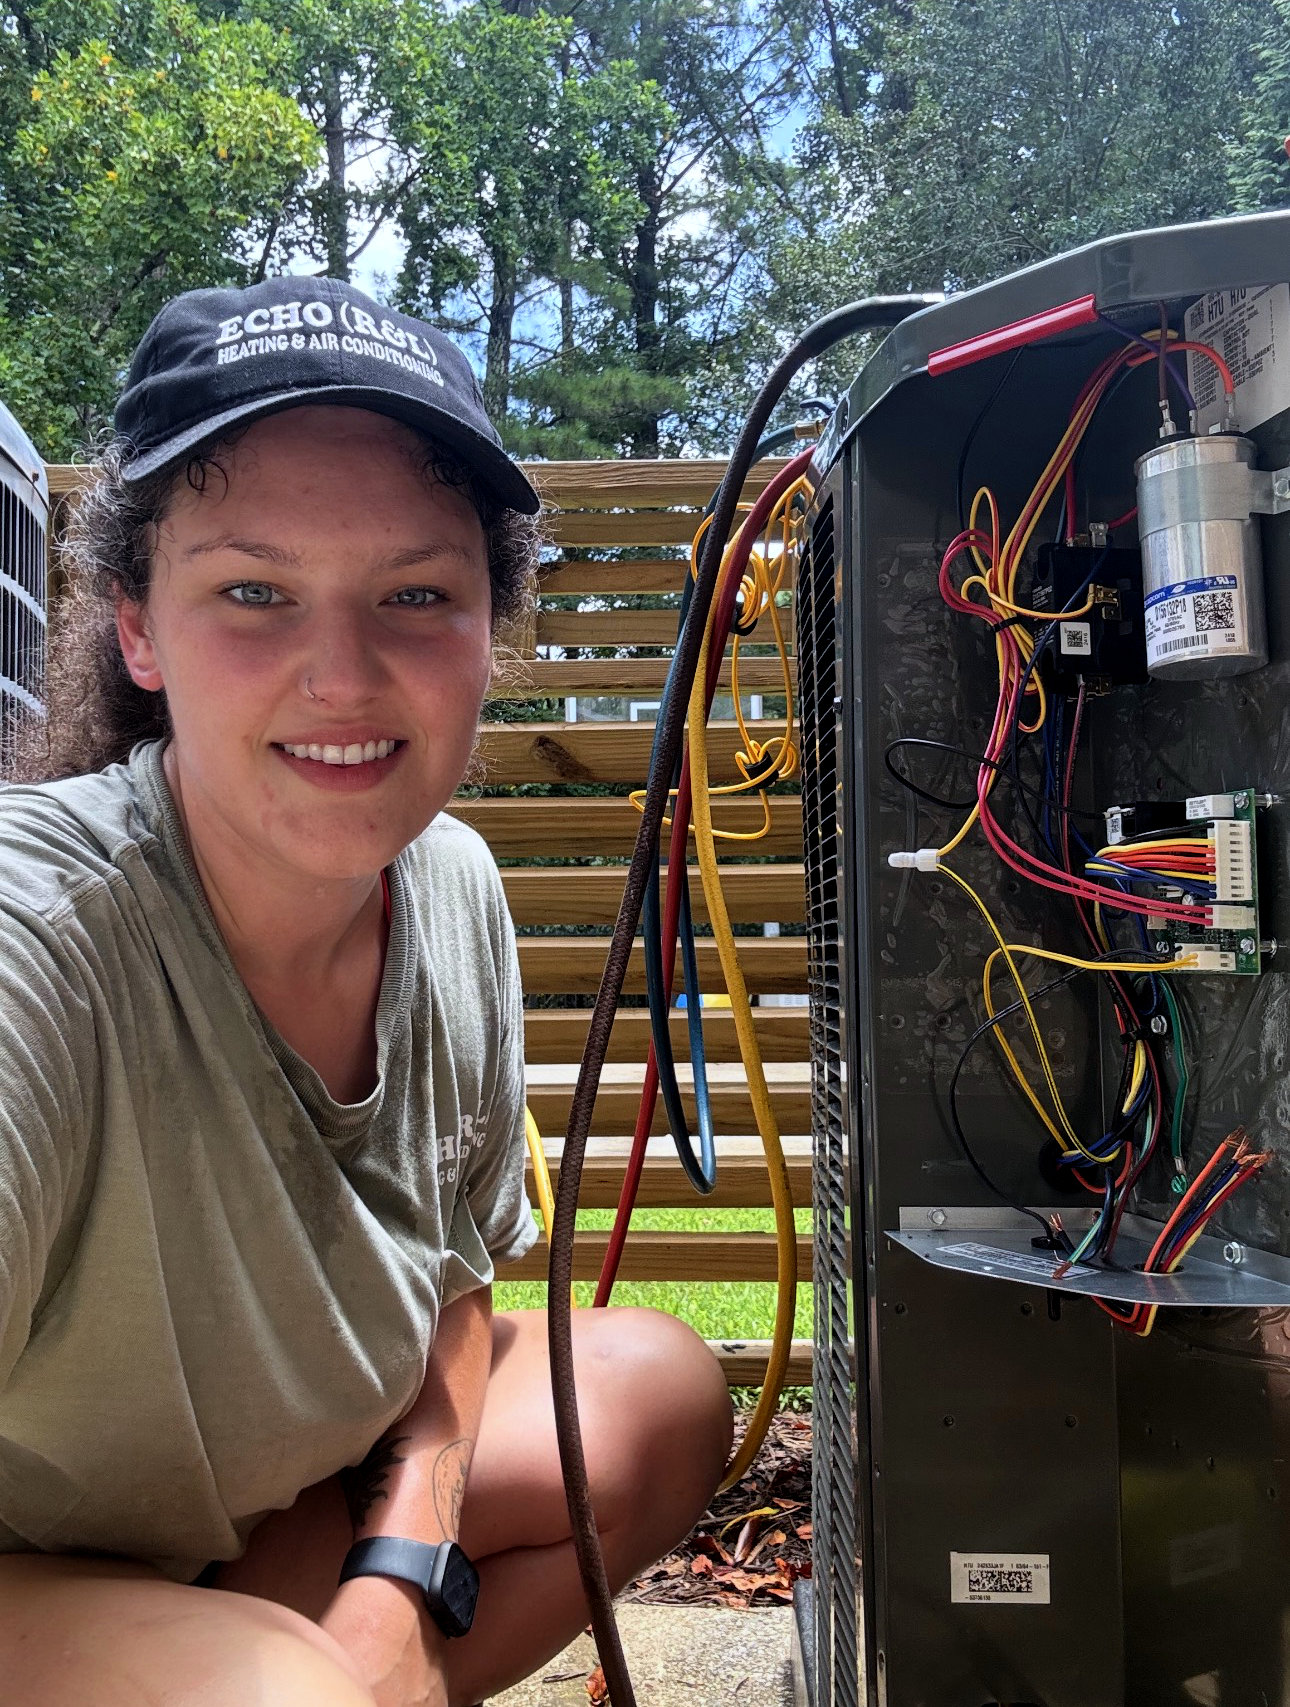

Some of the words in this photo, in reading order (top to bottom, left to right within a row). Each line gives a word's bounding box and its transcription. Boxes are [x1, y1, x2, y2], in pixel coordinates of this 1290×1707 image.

[216, 301, 333, 344] ECHO
[340, 300, 437, 366] (R&L)
[217, 334, 289, 364] HEATING
[291, 333, 305, 350] &
[309, 332, 340, 351] AIR
[342, 335, 444, 387] CONDITIONING
